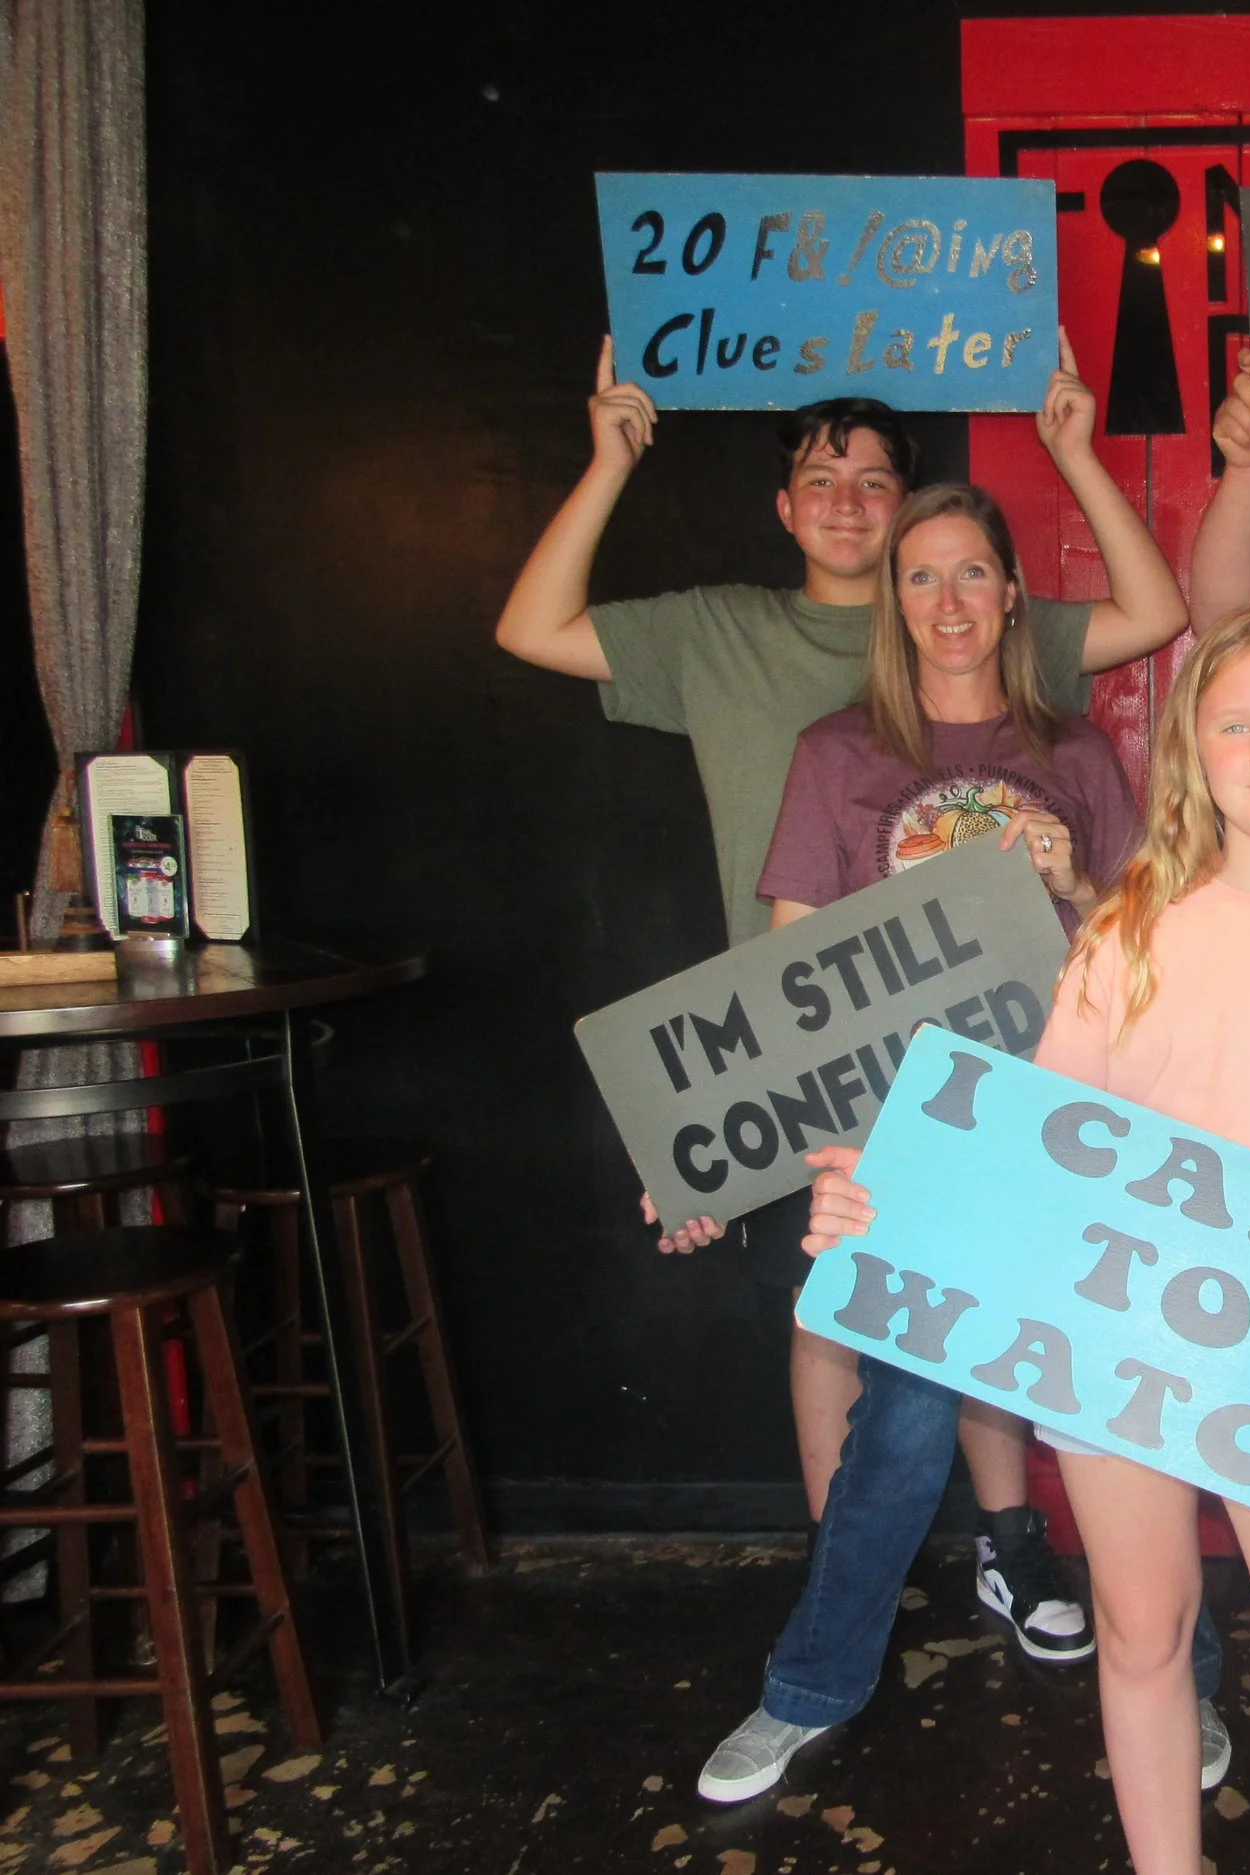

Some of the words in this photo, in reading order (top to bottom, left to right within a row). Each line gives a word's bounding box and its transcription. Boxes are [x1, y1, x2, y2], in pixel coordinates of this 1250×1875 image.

[631, 209, 728, 277] 20
[641, 307, 830, 379] Clues
[846, 309, 1032, 375] Later
[875, 801, 904, 875] CAMPFIRES
[899, 764, 965, 801] FLANELS
[977, 763, 1047, 800] PUMPKINS
[649, 990, 763, 1095] I'M
[781, 897, 984, 1032] STILL
[672, 979, 1046, 1194] CONFUED
[920, 1050, 994, 1131] I
